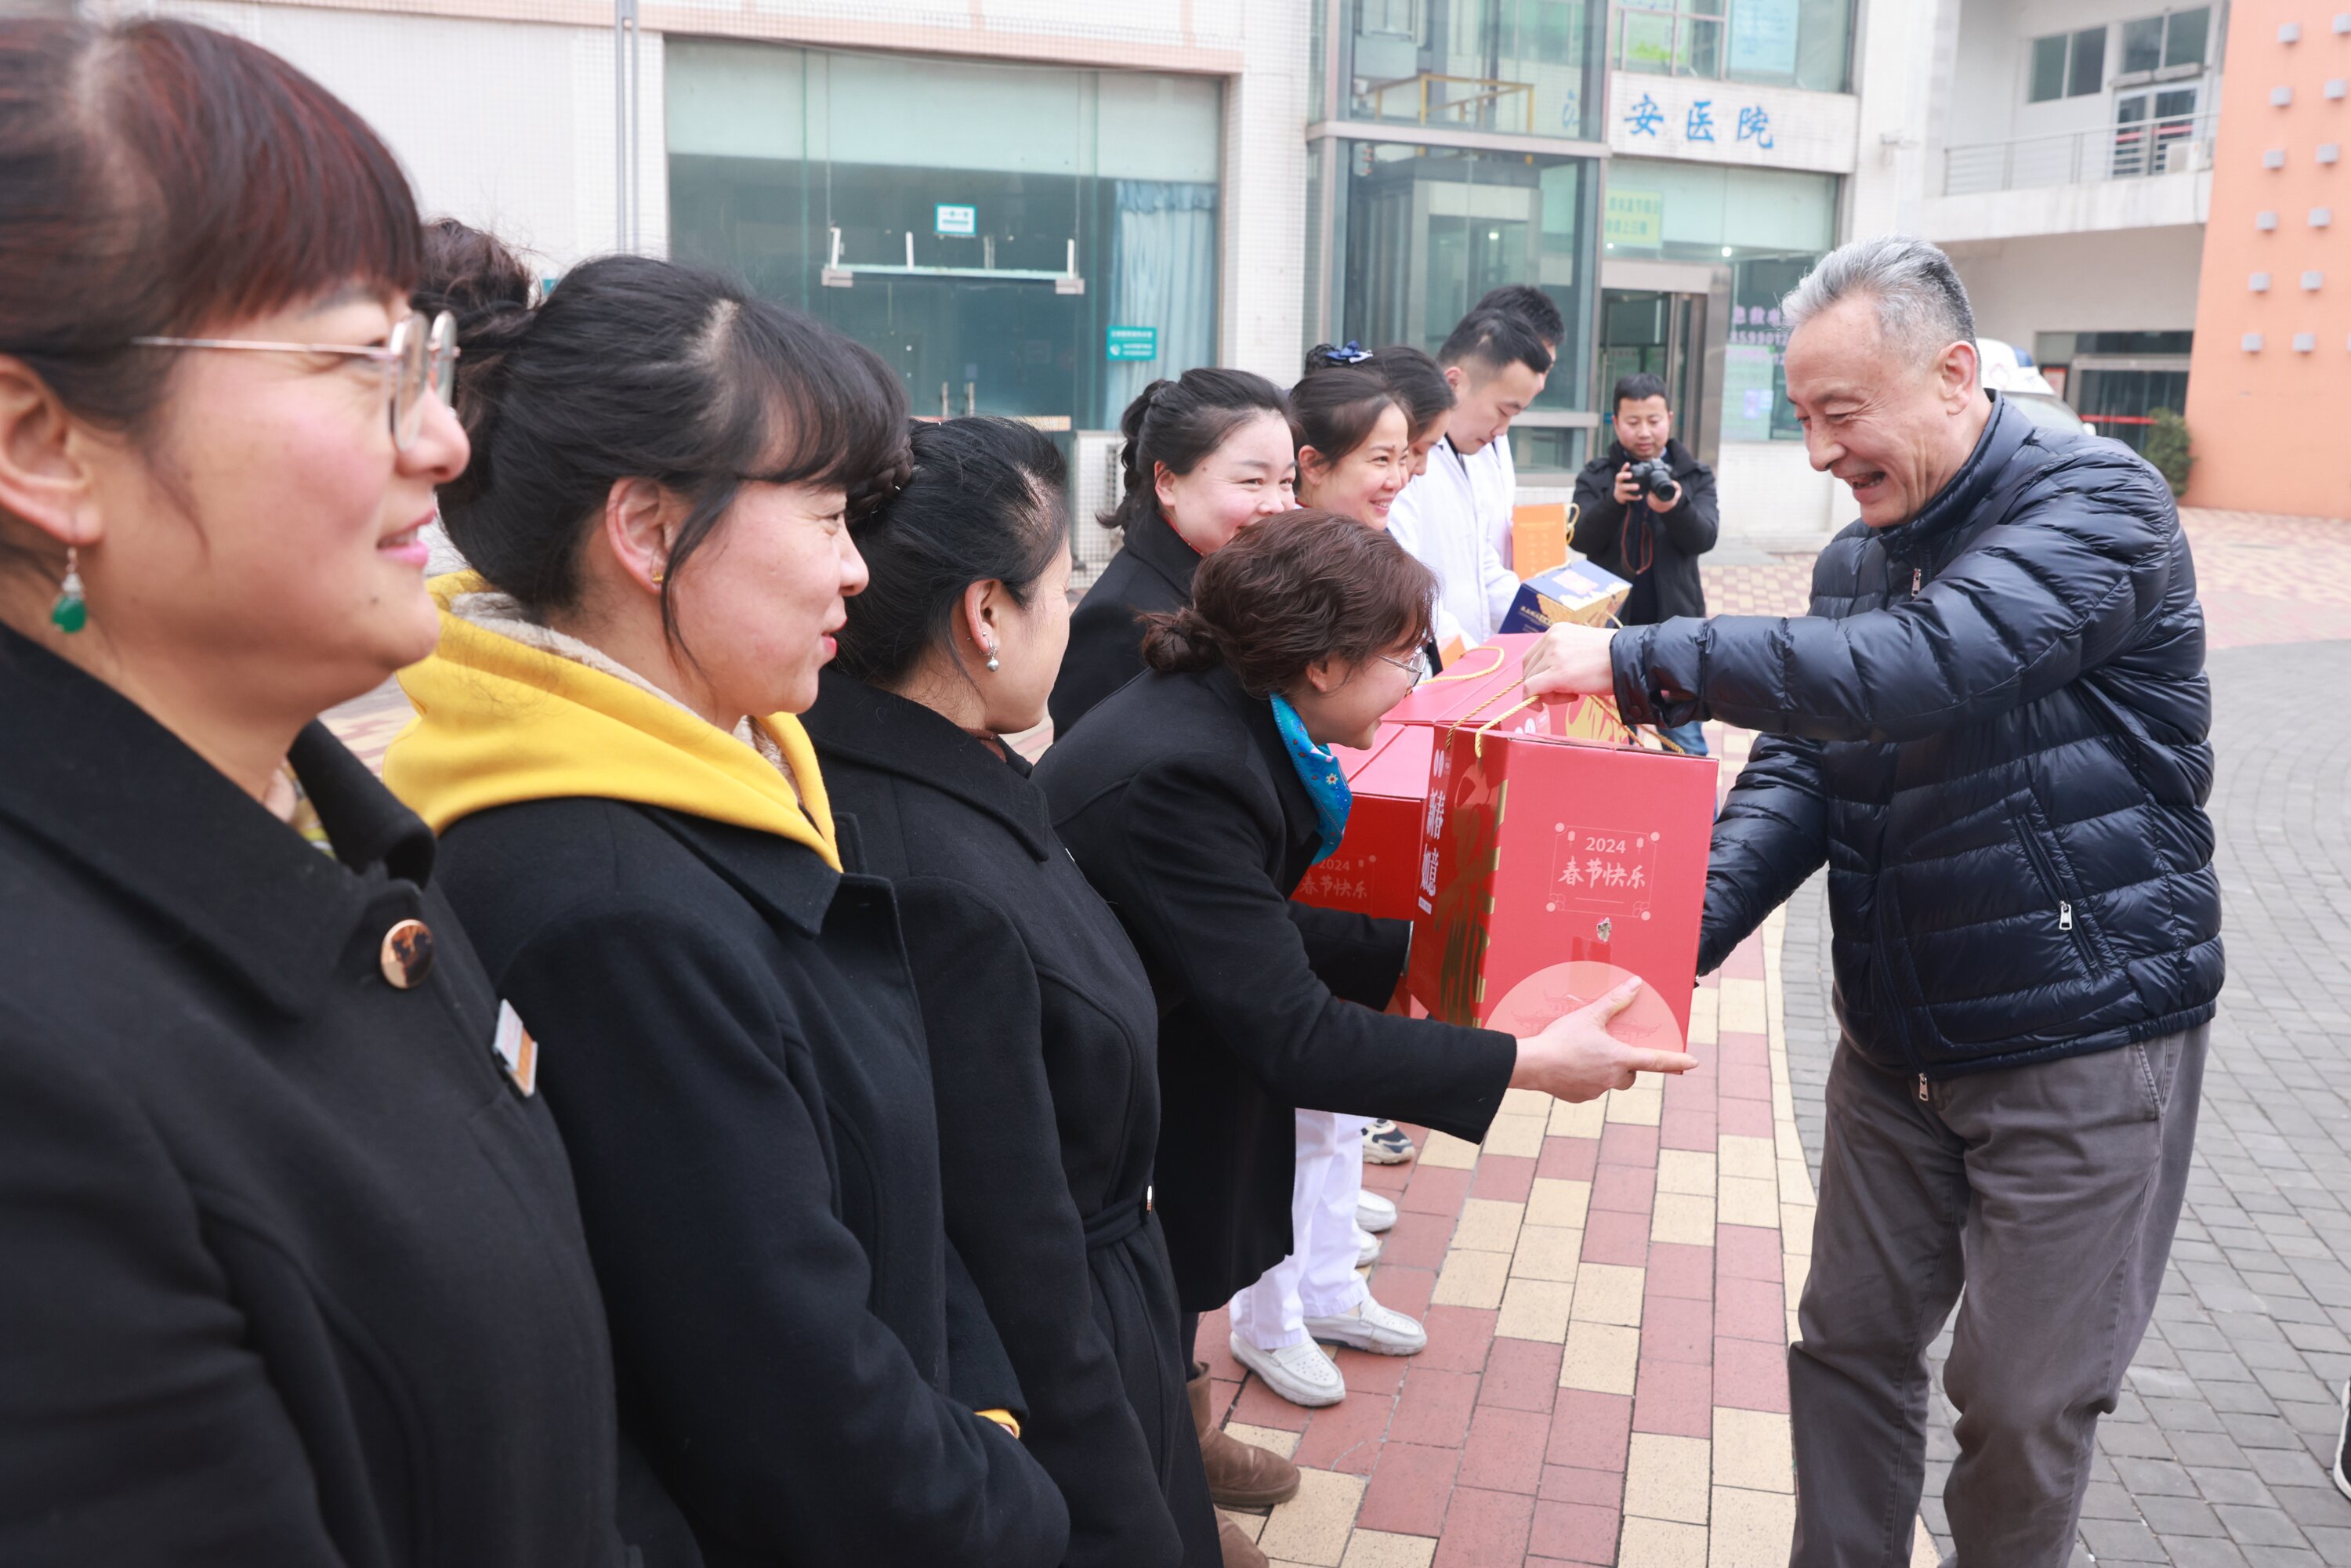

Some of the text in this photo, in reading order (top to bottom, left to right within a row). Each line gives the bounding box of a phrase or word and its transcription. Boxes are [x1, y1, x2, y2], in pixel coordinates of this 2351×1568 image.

[1426, 787, 1446, 840] 新春
[1585, 836, 1626, 854] 2024
[1318, 859, 1350, 871] 2024
[1557, 855, 1646, 889] 春节快乐
[1300, 872, 1367, 899] 春节快乐
